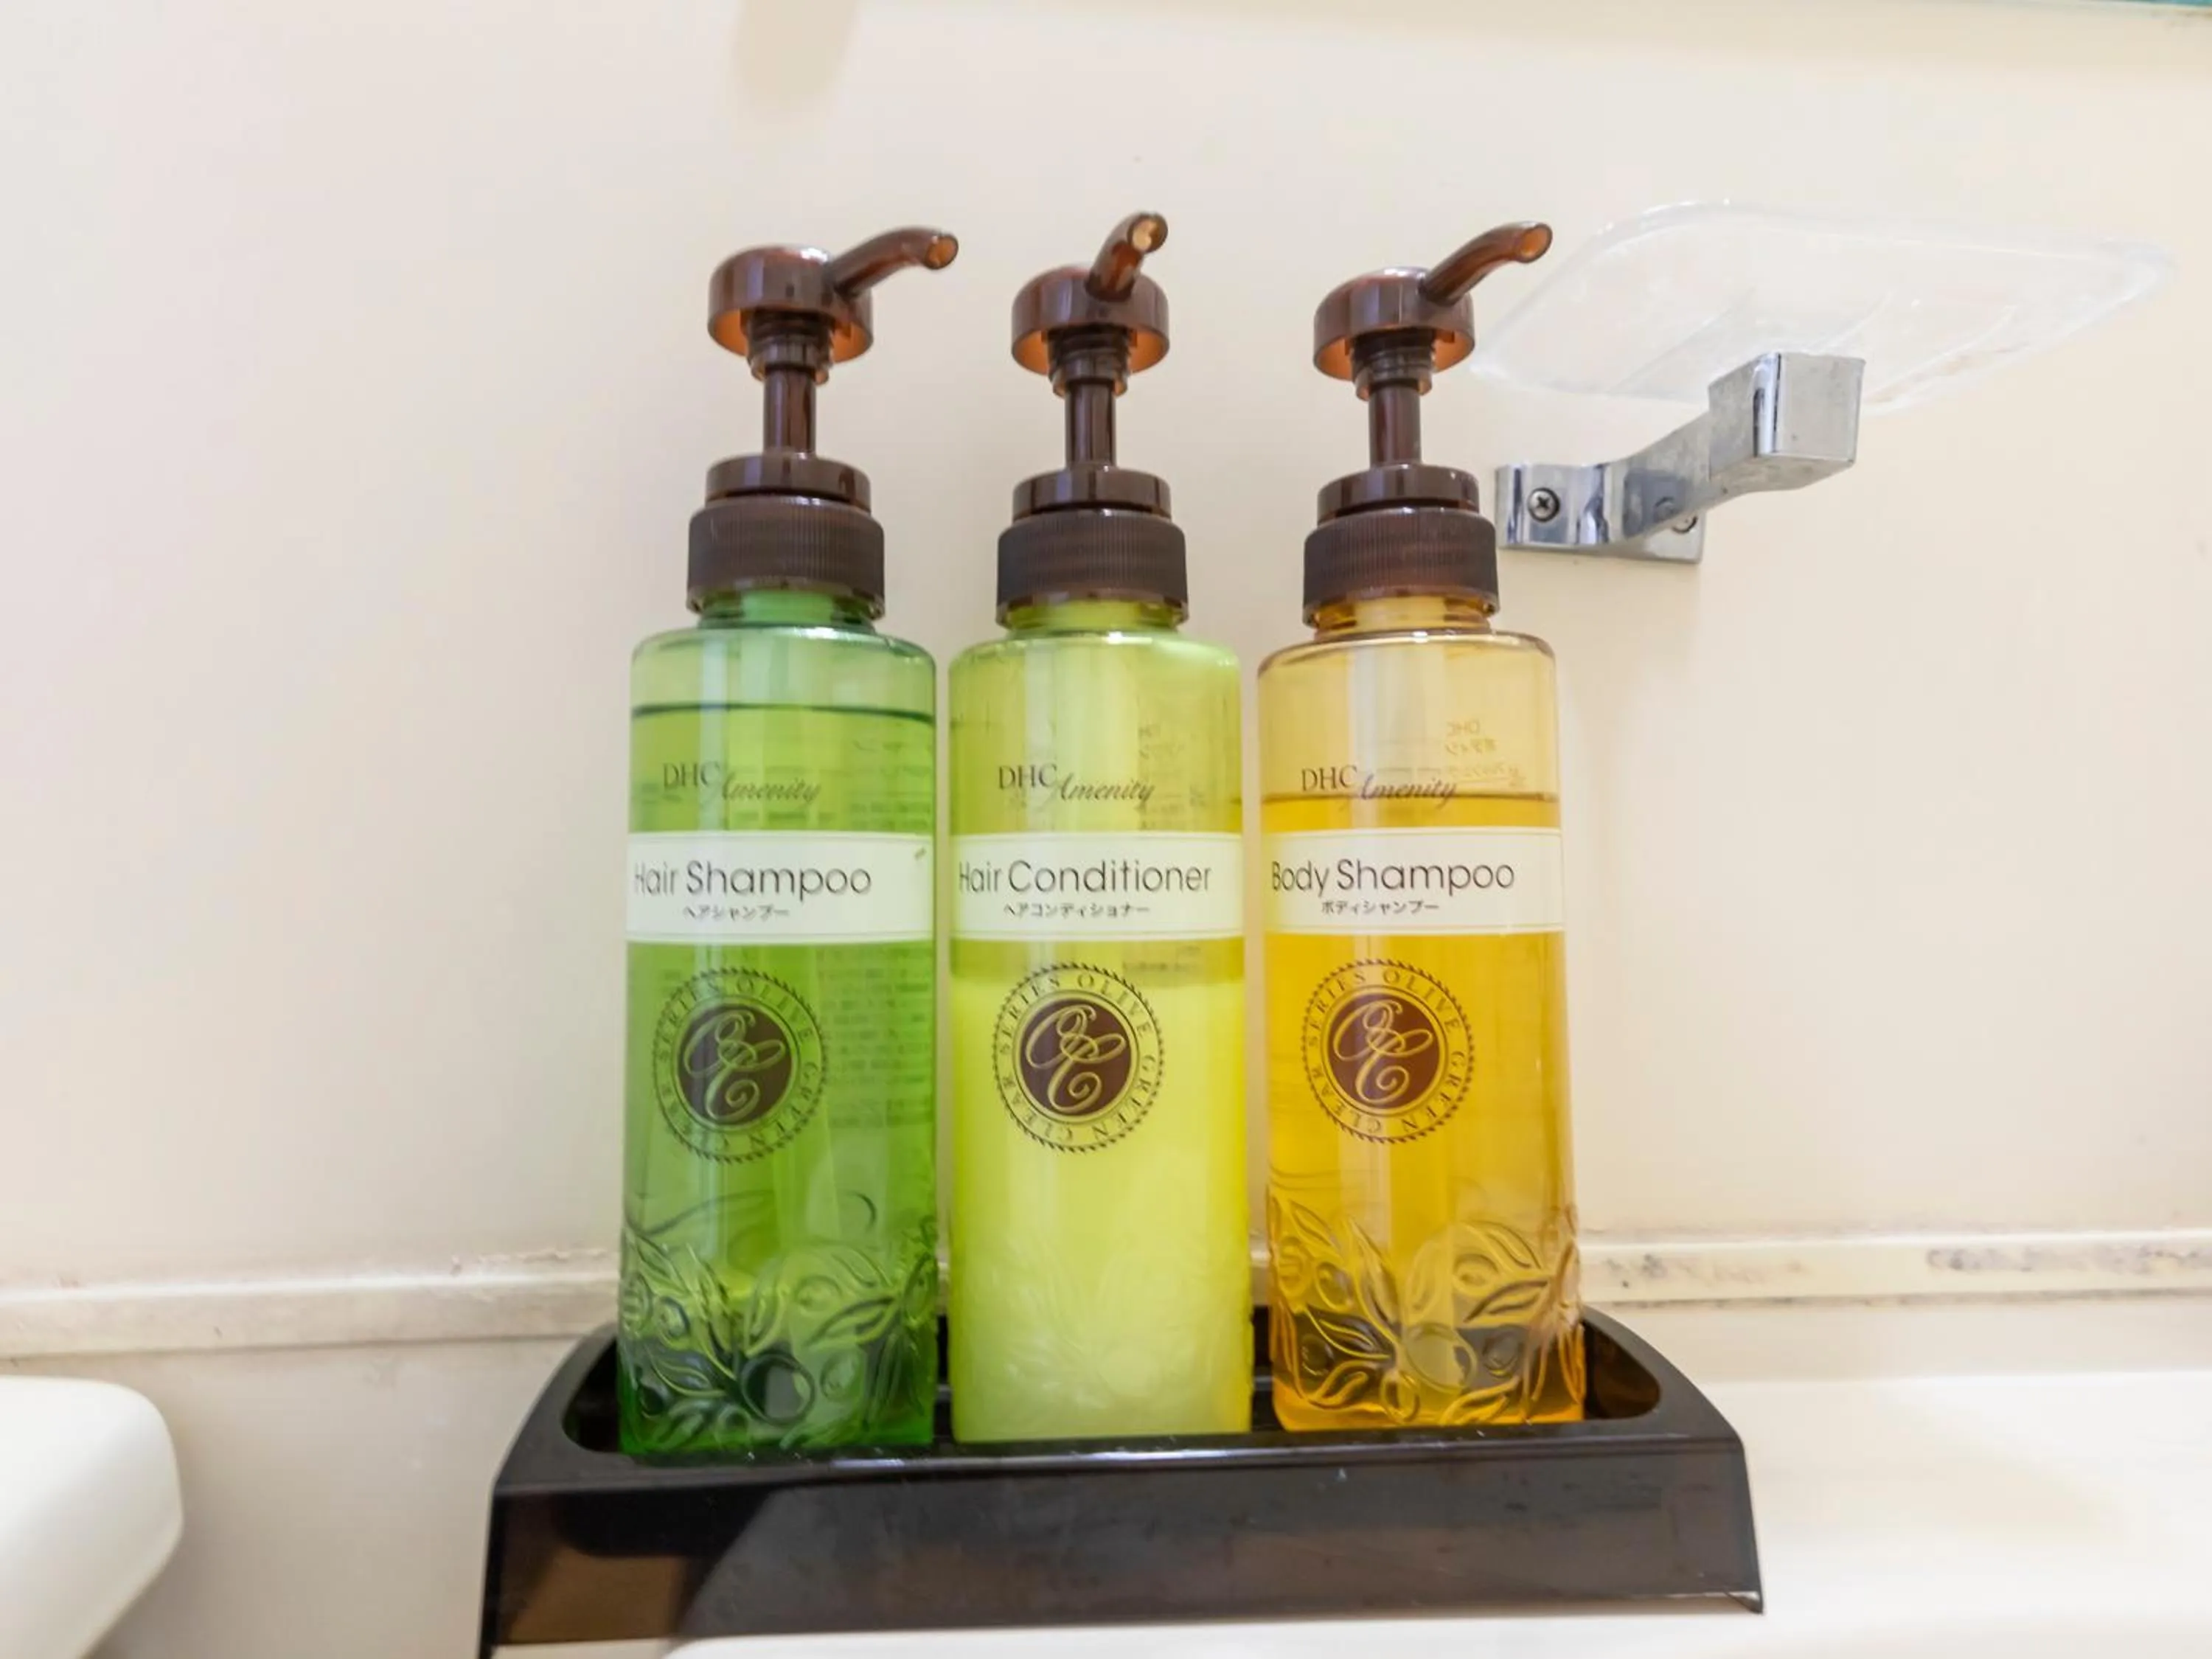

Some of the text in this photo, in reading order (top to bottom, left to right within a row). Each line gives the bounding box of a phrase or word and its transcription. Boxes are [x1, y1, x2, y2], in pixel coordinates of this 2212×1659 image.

[663, 760, 821, 804] DHC Amenity
[998, 763, 1155, 803] DHC Amenity
[1301, 765, 1358, 791] DHC
[1355, 773, 1458, 809] Amenity
[633, 859, 872, 902] Hair Shampoo
[959, 859, 1211, 894] Hair Conditioner
[1272, 858, 1515, 897] Body Shampoo
[1003, 902, 1151, 919] ヘアコンディショナー
[1077, 973, 1151, 1037] OLIVE
[1308, 970, 1367, 1047] SERIES
[1382, 969, 1461, 1033] OLIVE
[1092, 1054, 1155, 1141] GREEN
[1402, 1051, 1465, 1133] GREEN
